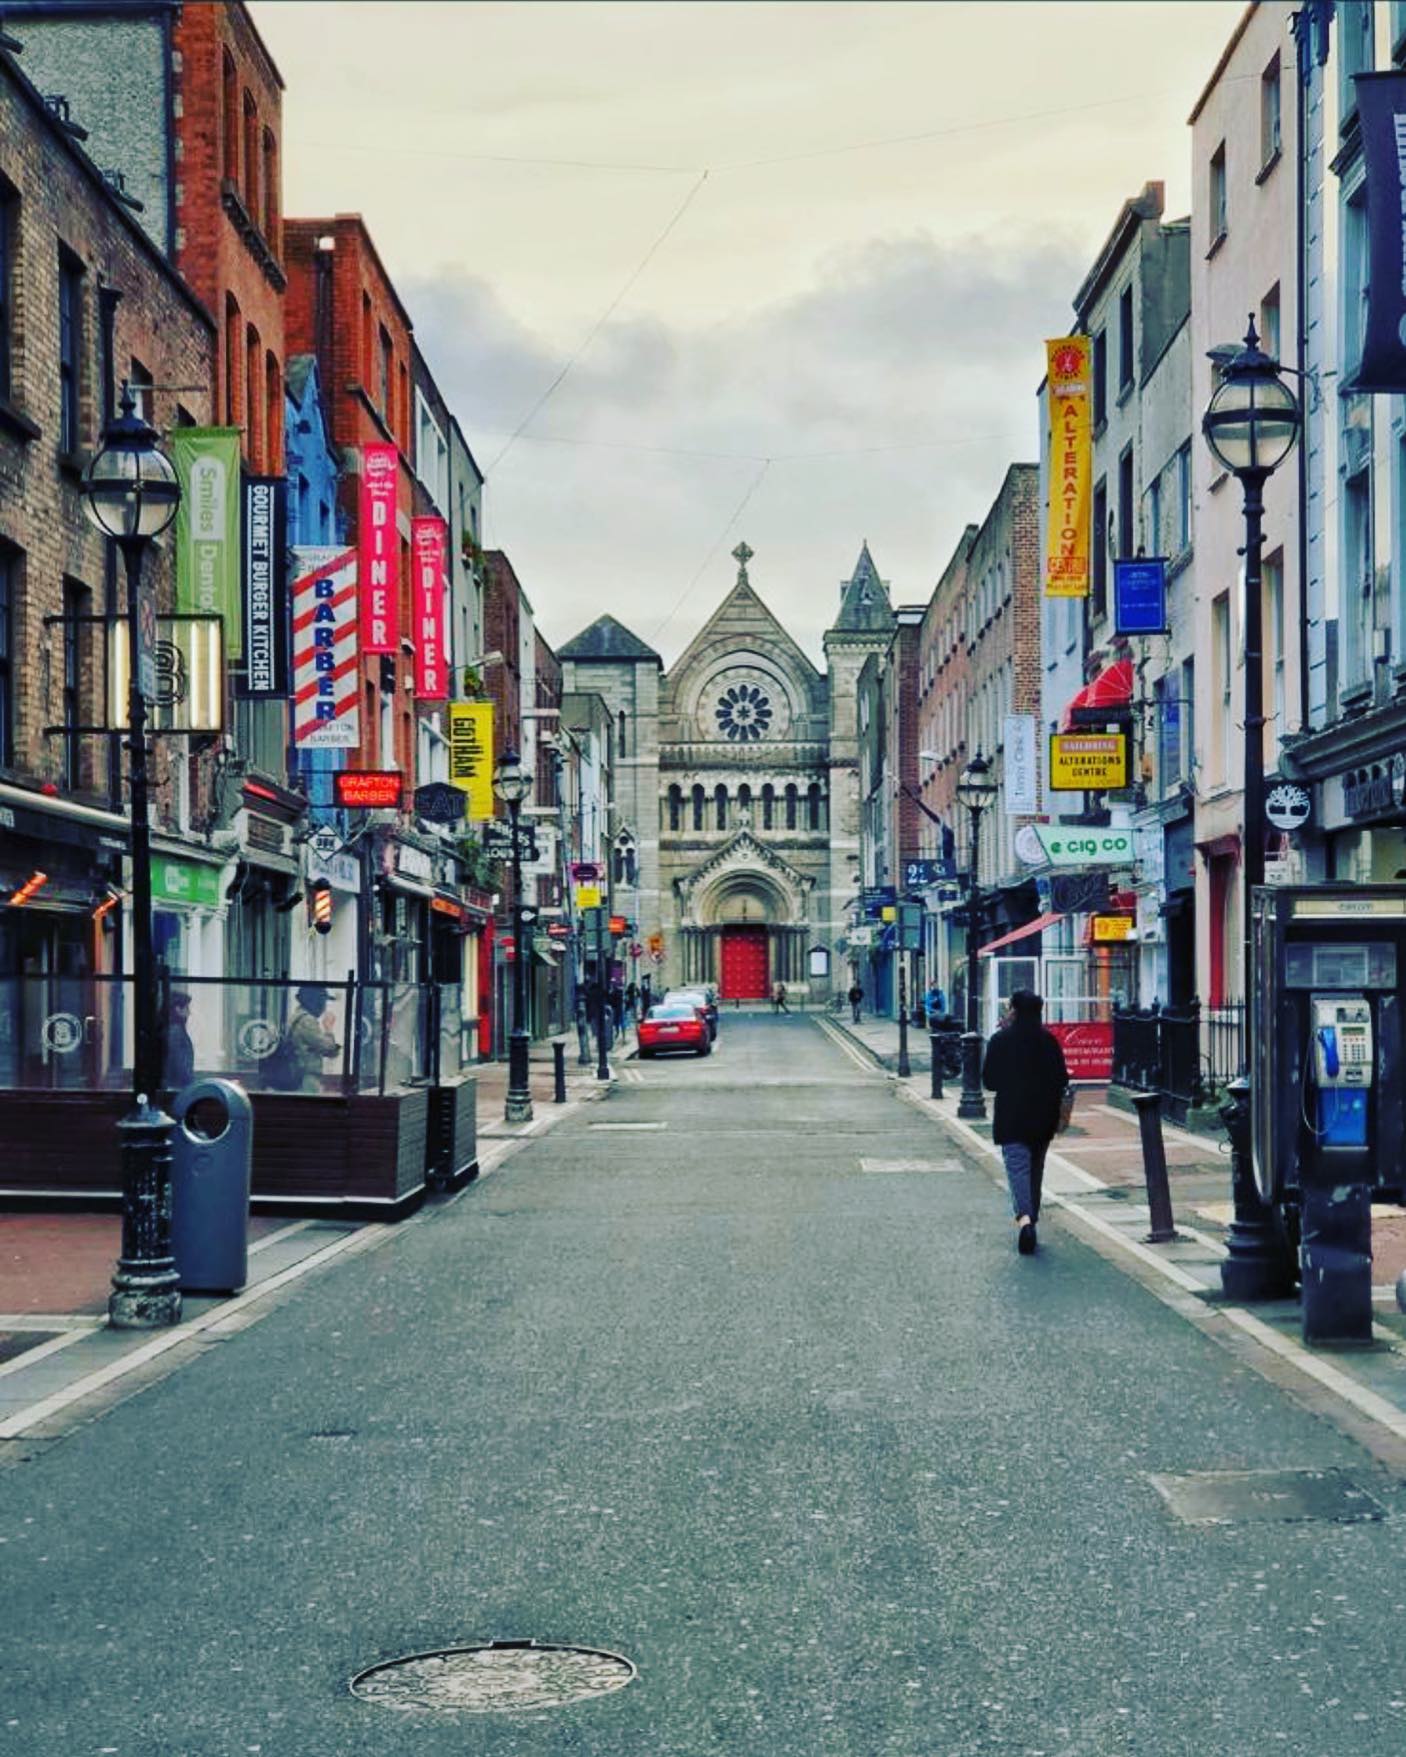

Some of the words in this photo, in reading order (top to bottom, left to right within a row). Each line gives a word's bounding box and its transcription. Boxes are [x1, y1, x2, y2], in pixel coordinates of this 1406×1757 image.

[199, 467, 219, 531] Smiles
[252, 485, 269, 556] GOURMET
[252, 562, 269, 620] BURGER
[371, 501, 387, 645] DINER
[252, 625, 269, 690] KITCHEN
[314, 579, 336, 720] BARBER
[421, 566, 438, 691] DINER
[453, 717, 486, 778] GOTHAM
[339, 776, 400, 788] GRAFTON
[344, 790, 396, 801] BARBER
[1051, 842, 1062, 853] e
